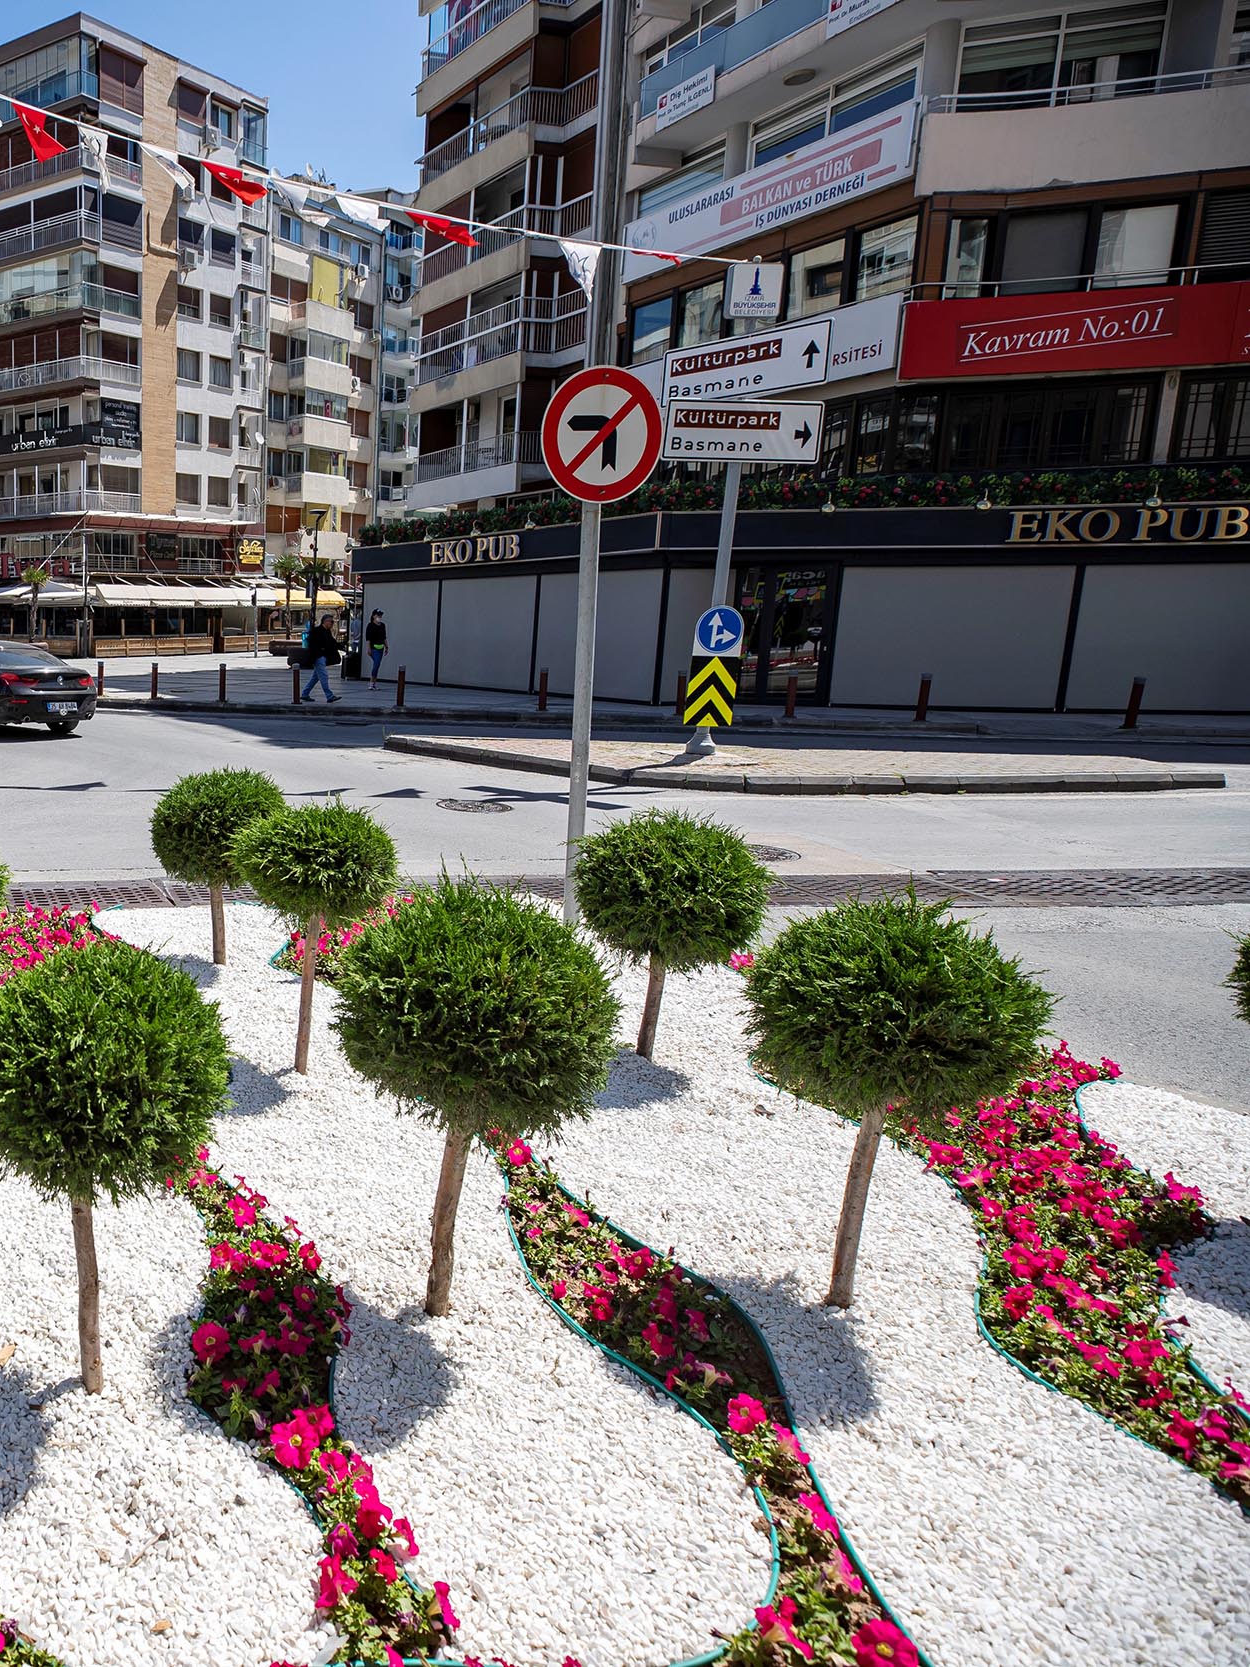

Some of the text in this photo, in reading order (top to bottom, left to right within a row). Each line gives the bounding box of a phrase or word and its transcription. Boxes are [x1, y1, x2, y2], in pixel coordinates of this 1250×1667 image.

[670, 74, 708, 102] Diş Hekimi
[741, 154, 854, 215] BALKAN ve TÜRK
[668, 185, 734, 225] ULUSLARARASI
[755, 175, 865, 229] İŞ DÜNYASI DERNEĞİ
[962, 306, 1167, 357] Kavram No:01
[671, 340, 781, 374] Kültürpark
[832, 339, 884, 367] RSİTESİ
[668, 373, 764, 399] Basmane
[675, 409, 780, 428] Kültürpark
[11, 433, 36, 451] urban
[92, 428, 116, 446] urban
[670, 436, 764, 452] Basmane
[1005, 506, 1250, 543] EKO PUB
[430, 534, 521, 565] EKO PUB
